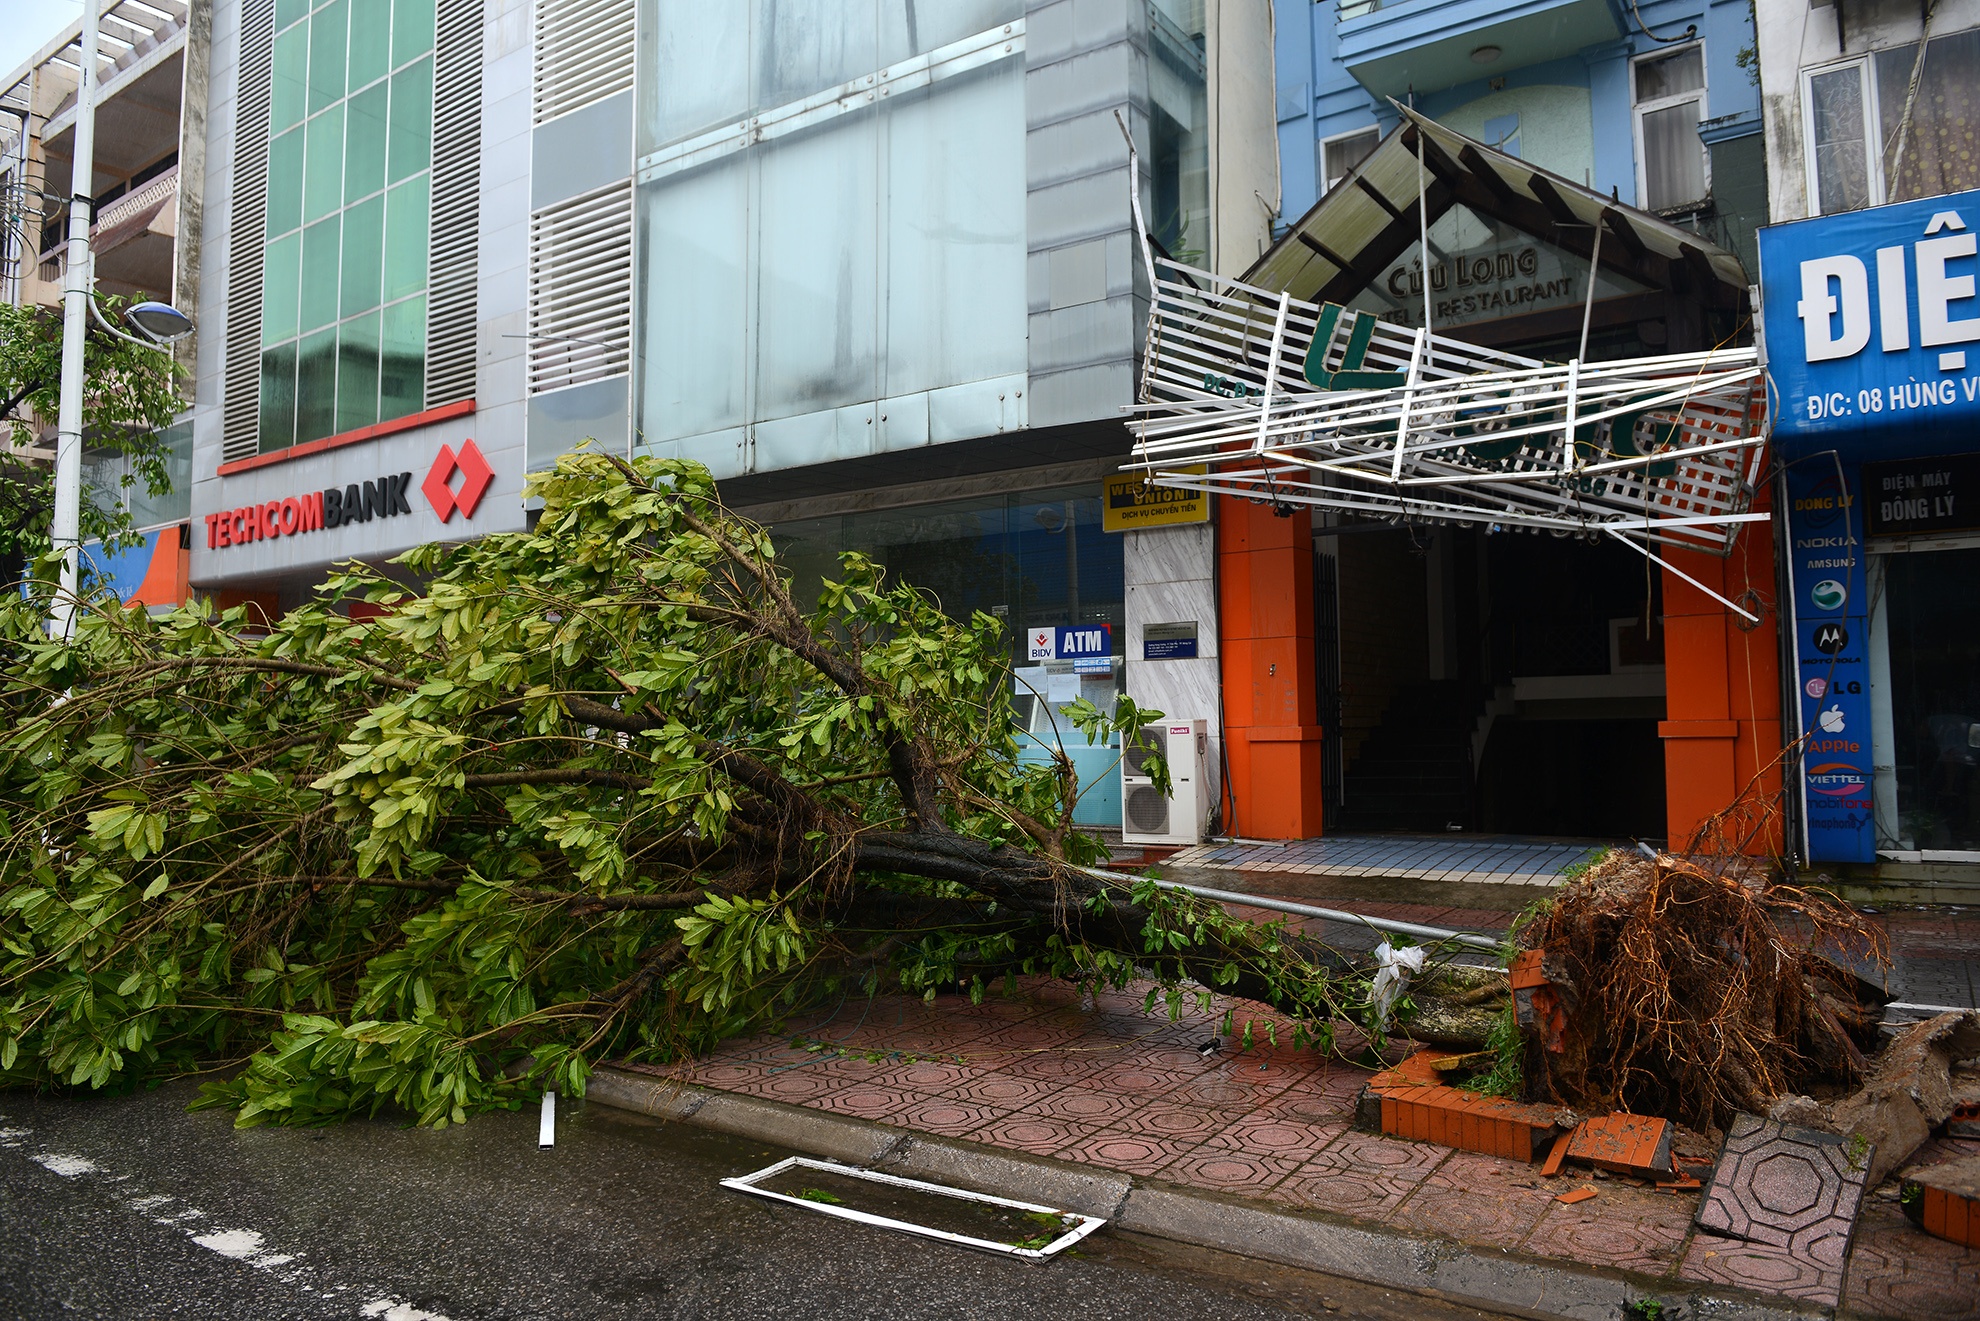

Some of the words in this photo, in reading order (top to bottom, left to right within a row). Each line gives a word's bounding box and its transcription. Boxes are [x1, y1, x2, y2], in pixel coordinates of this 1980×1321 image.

[1437, 277, 1573, 319] RESTAURANT
[1807, 393, 1851, 420] Đ/C:
[1858, 388, 1883, 414] 08
[1889, 376, 1956, 411] HÙNG
[1961, 376, 1980, 402] V
[1882, 473, 1915, 492] ĐIỆN
[1922, 469, 1951, 487] MÁY
[1134, 488, 1185, 505] UNION
[205, 471, 412, 549] TECHCOMBANK
[1881, 495, 1928, 521] ĐÔNG
[1935, 490, 1955, 517] LÝ
[1122, 510, 1138, 520] DỊCH
[1140, 509, 1149, 519] VỤ
[1797, 537, 1858, 549] NOKIA
[1032, 648, 1052, 657] BIDV
[1063, 630, 1102, 653] ATM
[1801, 657, 1862, 665] MOTOROLA
[1833, 681, 1862, 694] LG
[1807, 775, 1865, 784] VIETTEL
[1809, 816, 1856, 831] inaphone
